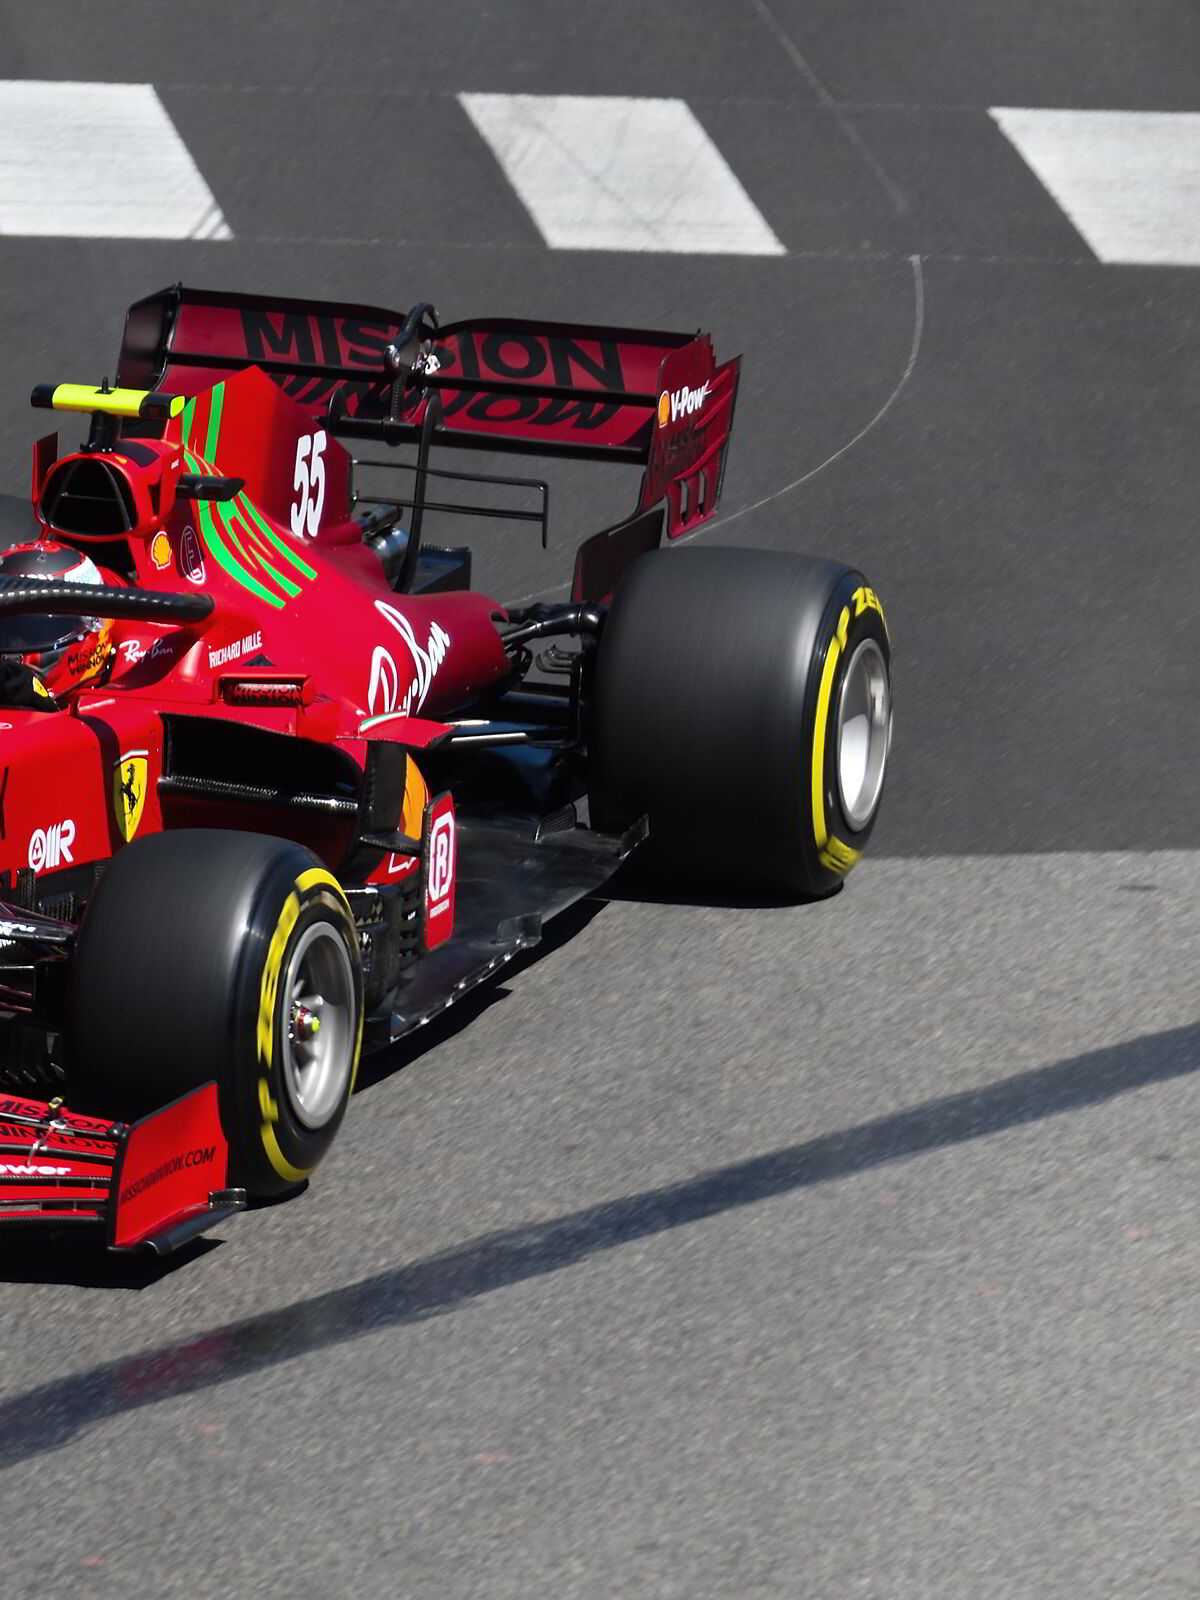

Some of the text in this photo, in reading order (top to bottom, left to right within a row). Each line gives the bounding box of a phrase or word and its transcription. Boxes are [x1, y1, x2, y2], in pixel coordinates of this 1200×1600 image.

[671, 380, 712, 422] V-Pow
[290, 430, 327, 538] 55
[118, 637, 175, 664] Ray-Ban
[208, 630, 263, 669] RICHARD MILLE
